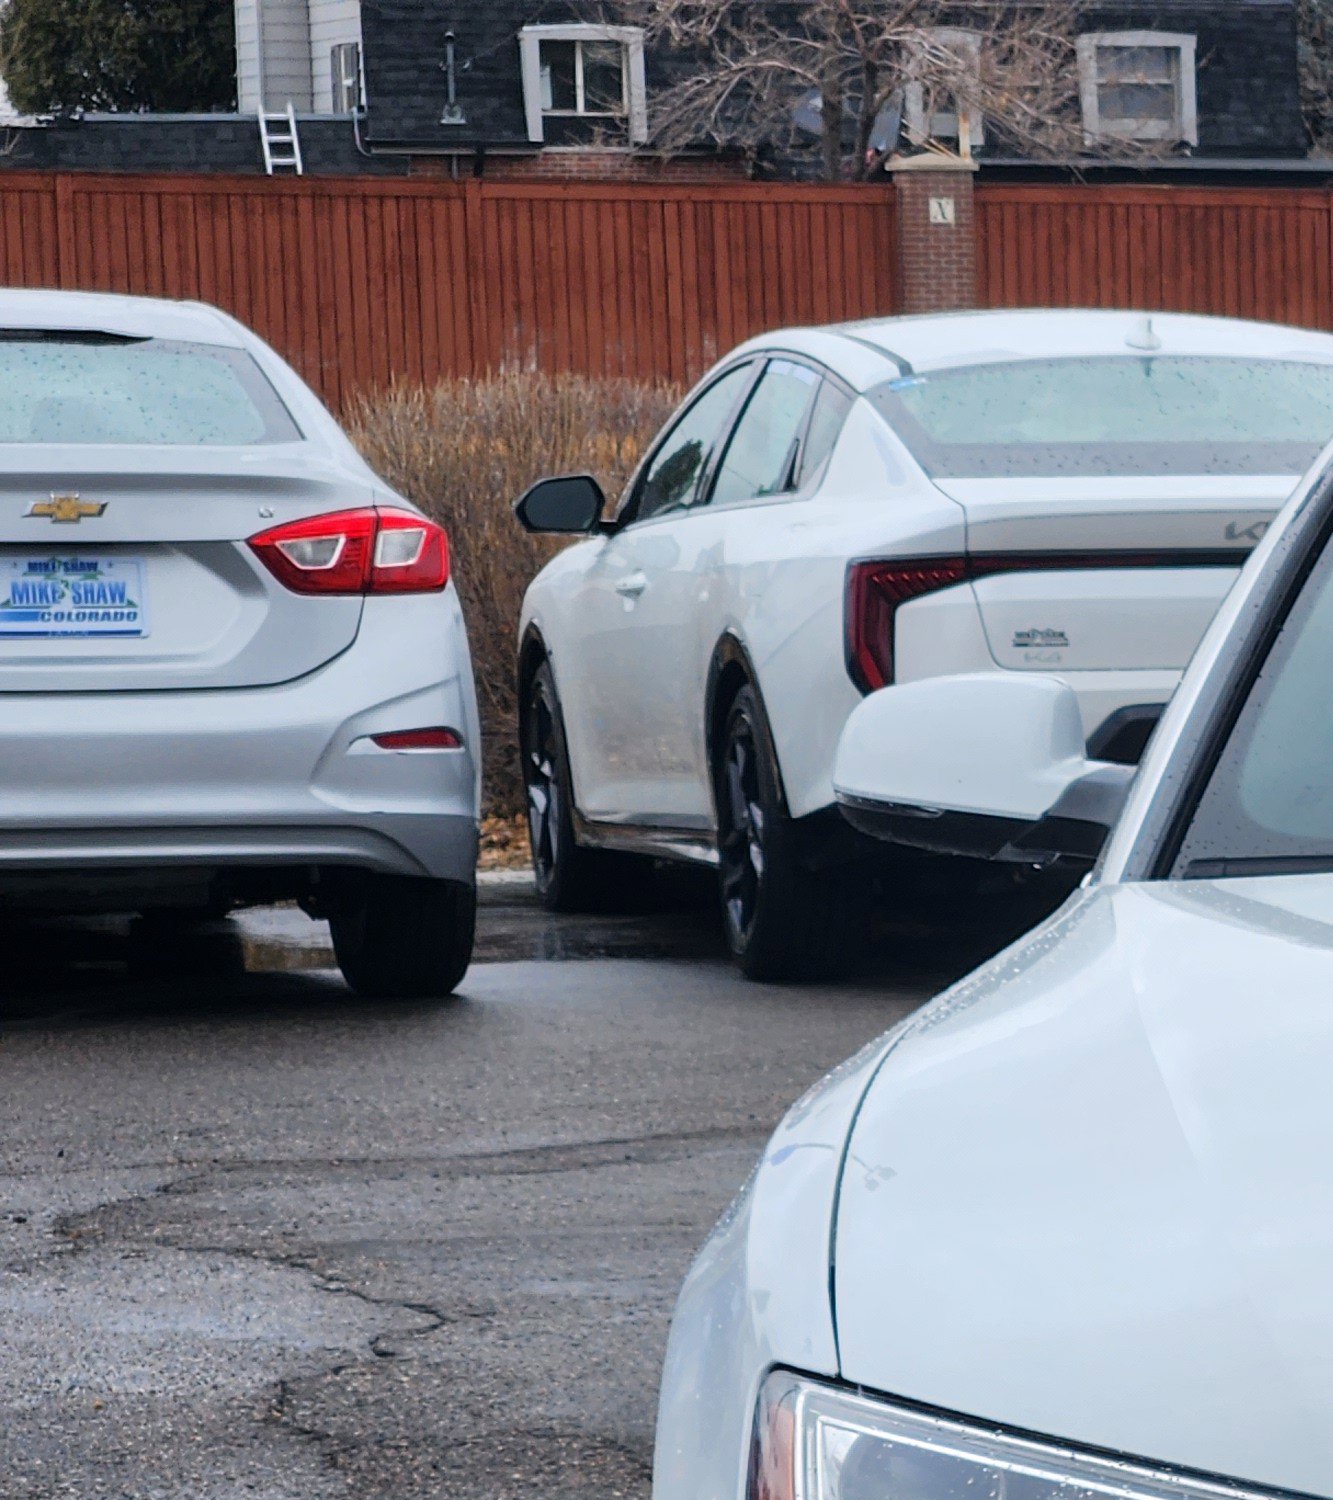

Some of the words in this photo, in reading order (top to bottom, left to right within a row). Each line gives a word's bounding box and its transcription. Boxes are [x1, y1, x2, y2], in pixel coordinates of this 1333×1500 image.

[11, 581, 60, 604] MIKE
[72, 581, 126, 604] SHAW
[40, 611, 138, 622] COLORADO
